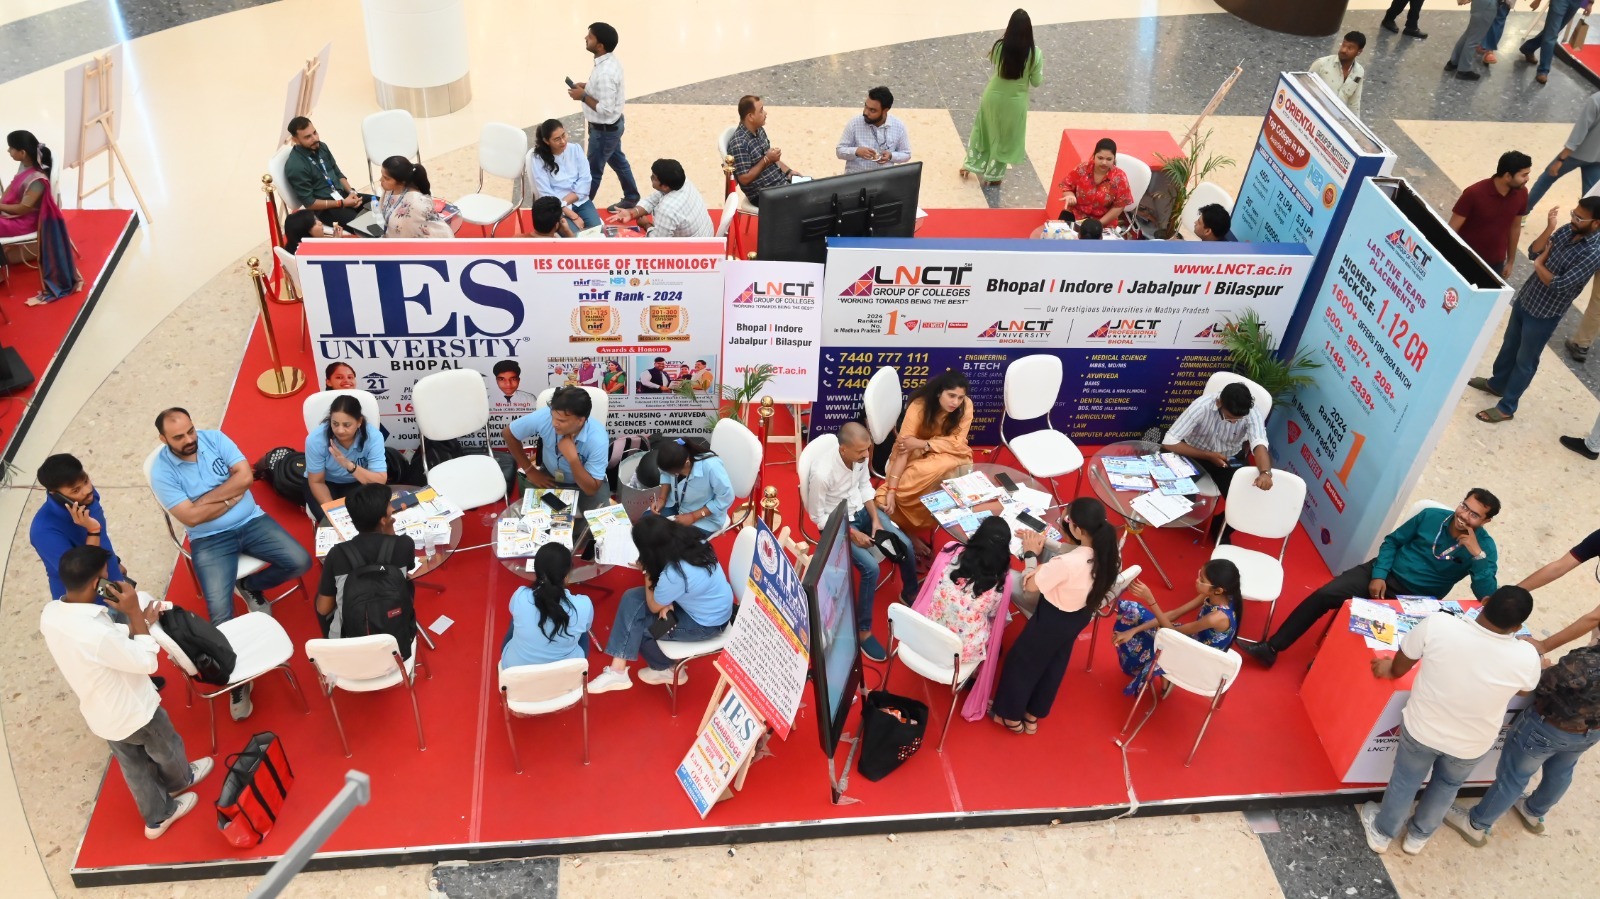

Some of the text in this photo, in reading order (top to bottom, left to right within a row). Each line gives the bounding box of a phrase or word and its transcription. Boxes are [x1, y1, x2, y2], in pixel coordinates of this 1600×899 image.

[1268, 116, 1276, 130] Top
[1276, 126, 1292, 146] College
[1285, 98, 1316, 140] ORIENTAL
[1400, 228, 1432, 267] LNCT
[533, 258, 718, 270] IES COLLEGE OF TECHNOLOGY
[875, 266, 972, 286] LNCT
[1173, 263, 1292, 276] www.LNCT.ac.in
[1342, 254, 1378, 297] HIGHEST
[1366, 238, 1427, 310] LAST FIVE YEARS
[306, 258, 524, 338] IES
[578, 288, 683, 302] nirf Rank 2024
[754, 282, 814, 296] LNCT
[873, 288, 970, 298] GROUP OF COLLEGES
[986, 278, 1284, 298] Bhopal Indore Jabalpur Bilaspur
[1368, 258, 1416, 314] PLACEMENTS
[1060, 306, 1100, 314] Prestigious
[1154, 306, 1180, 314] Madhya
[1338, 266, 1376, 316] PACKAGE:
[1376, 299, 1409, 348] 1.12
[1403, 332, 1429, 373] CR
[736, 323, 804, 333] Bhopal Indore
[998, 320, 1054, 331] LNCT
[1110, 320, 1162, 330] JNCT
[1332, 283, 1358, 322] 1600+
[1358, 320, 1374, 344] OFFERS
[1374, 340, 1384, 356] FOR
[1384, 352, 1396, 370] 2024
[1394, 367, 1412, 390] BATCH
[317, 338, 521, 360] UNIVERSITY
[728, 336, 812, 348] Jabalpur Bilaspur
[1325, 306, 1344, 333] 500+
[1346, 334, 1371, 368] 9877+
[1374, 370, 1395, 400] 208+
[390, 360, 464, 372] BHOPAL
[840, 352, 929, 362] 7440 777 111
[838, 366, 929, 376] 7440 222
[902, 378, 927, 388] 555
[1324, 340, 1347, 372] 1148+
[1350, 376, 1375, 410] 2339+
[366, 379, 385, 390] 21
[1296, 402, 1316, 434] Madhya
[1314, 428, 1336, 462] Pradesh
[1318, 405, 1344, 442] Ranked
[1330, 407, 1347, 434] 2024
[1326, 434, 1338, 452] No.
[1333, 430, 1367, 492] 1
[1326, 481, 1345, 510] Outlook
[723, 693, 756, 741] IES
[704, 732, 724, 762] ADMISSIONS
[712, 717, 742, 758] CAMBRIDGE
[690, 752, 706, 776] Early
[703, 772, 716, 794] Bird
[690, 770, 704, 791] Offer
